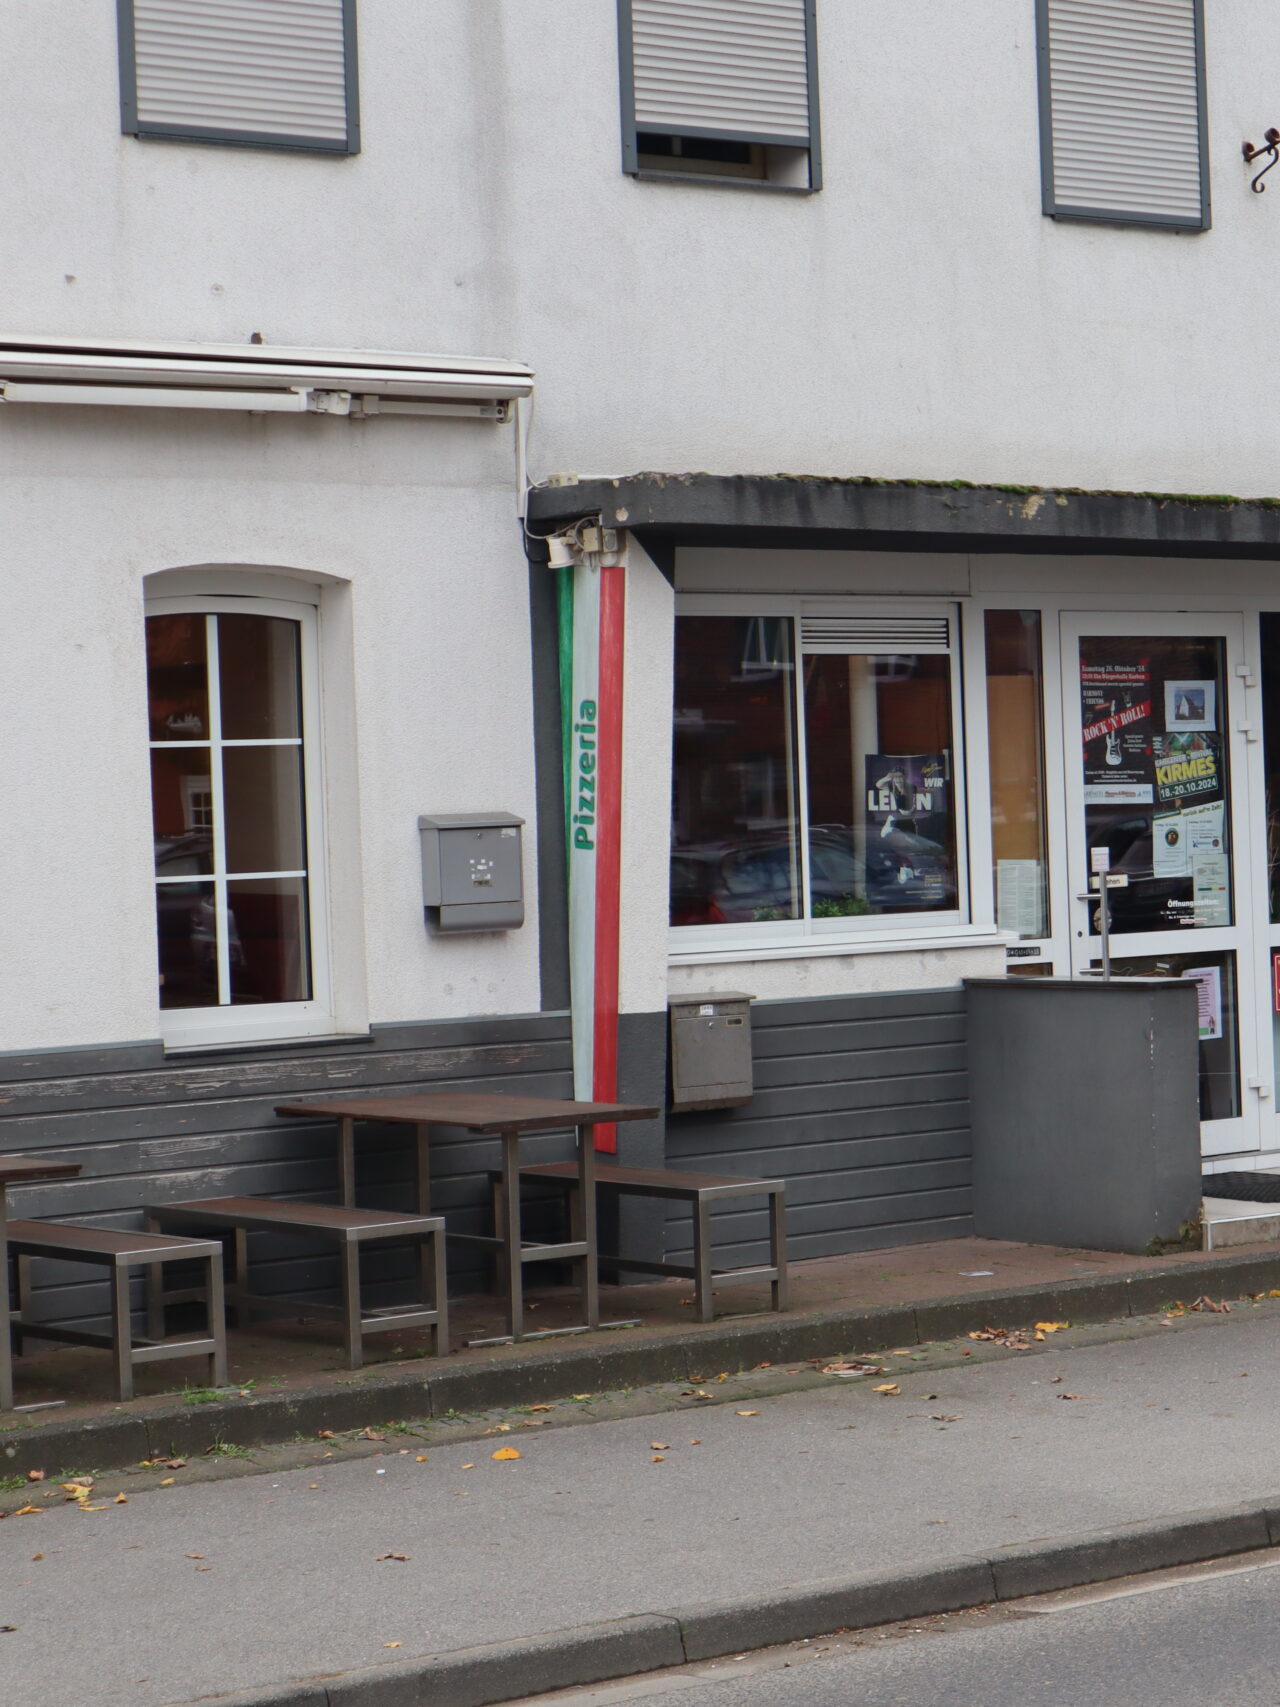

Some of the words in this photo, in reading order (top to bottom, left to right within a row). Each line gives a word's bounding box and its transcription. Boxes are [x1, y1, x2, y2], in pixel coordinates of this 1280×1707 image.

[1083, 721, 1108, 741] ROCK
[1120, 704, 1146, 726] ROLL!
[573, 699, 597, 850] Pizzeria
[924, 777, 944, 788] WIR
[1155, 756, 1216, 786] KIRMES
[867, 789, 932, 812] LEN
[1160, 777, 1217, 798] 18.-20.10.2024
